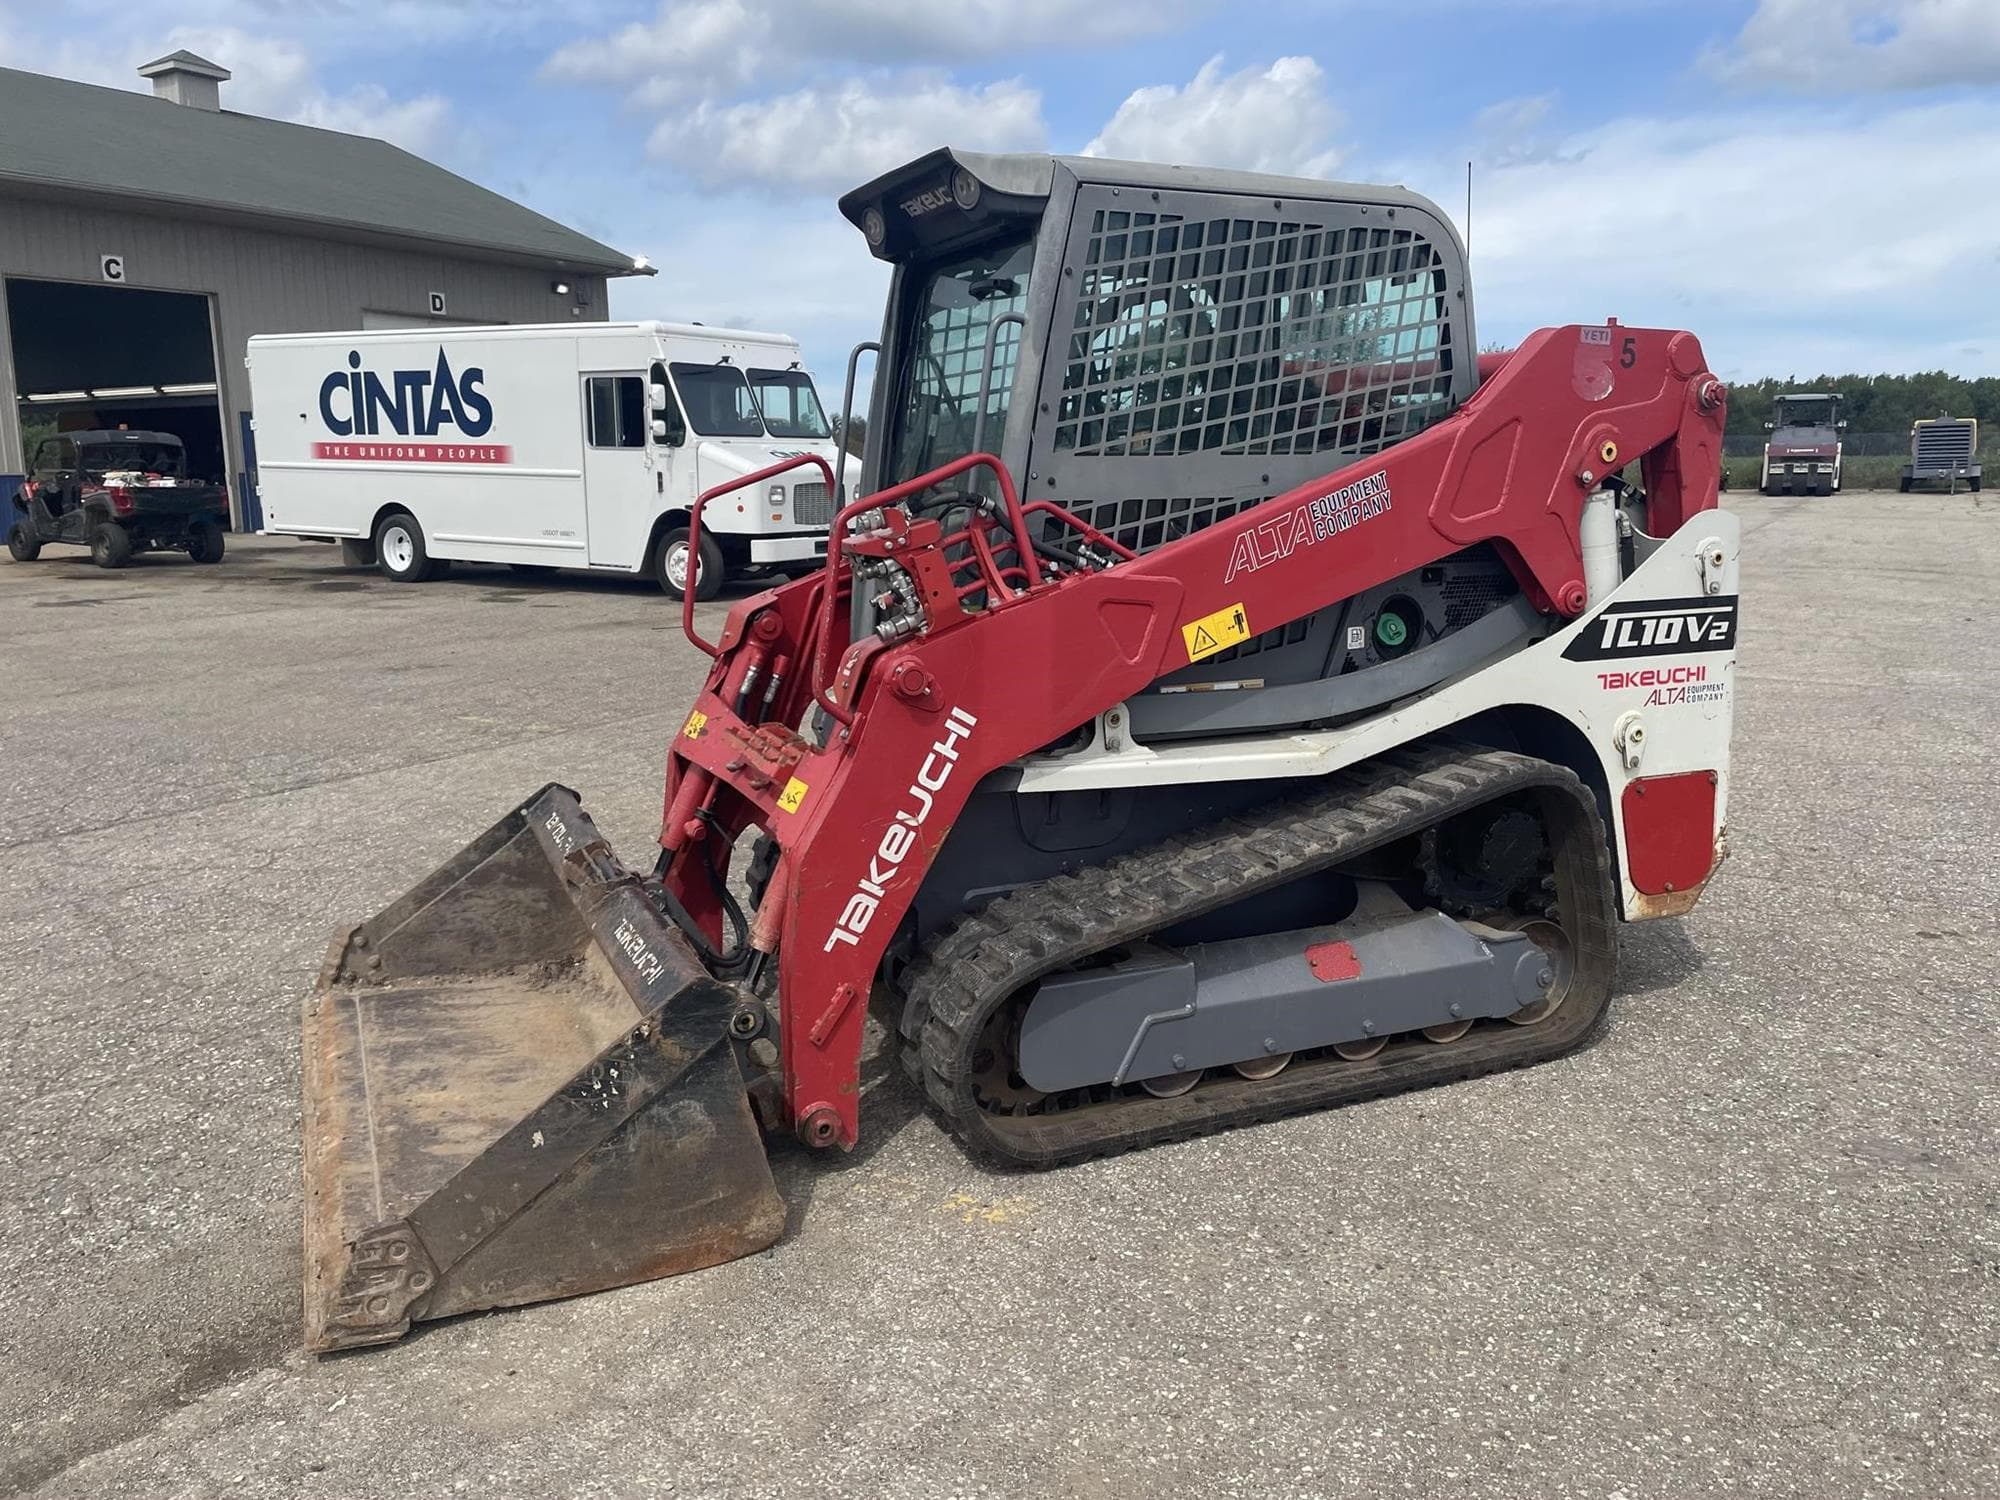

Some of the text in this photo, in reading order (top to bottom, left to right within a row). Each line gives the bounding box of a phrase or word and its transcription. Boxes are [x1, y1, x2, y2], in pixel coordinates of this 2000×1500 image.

[900, 185, 953, 217] TAKEUC
[104, 258, 122, 279] C
[431, 294, 443, 312] D
[1583, 330, 1609, 342] YETI
[1620, 338, 1636, 369] 5
[319, 344, 493, 438] CINTAS
[324, 445, 496, 460] THE UNIFORM PEOPLE
[1309, 470, 1388, 521] EQUIPMENT
[1314, 490, 1392, 542] COMPANY
[1224, 506, 1315, 584] ALTA
[1600, 606, 1734, 649] TL10V2
[1643, 686, 1686, 707] ALTA
[1687, 683, 1725, 694] EQUIPMENT
